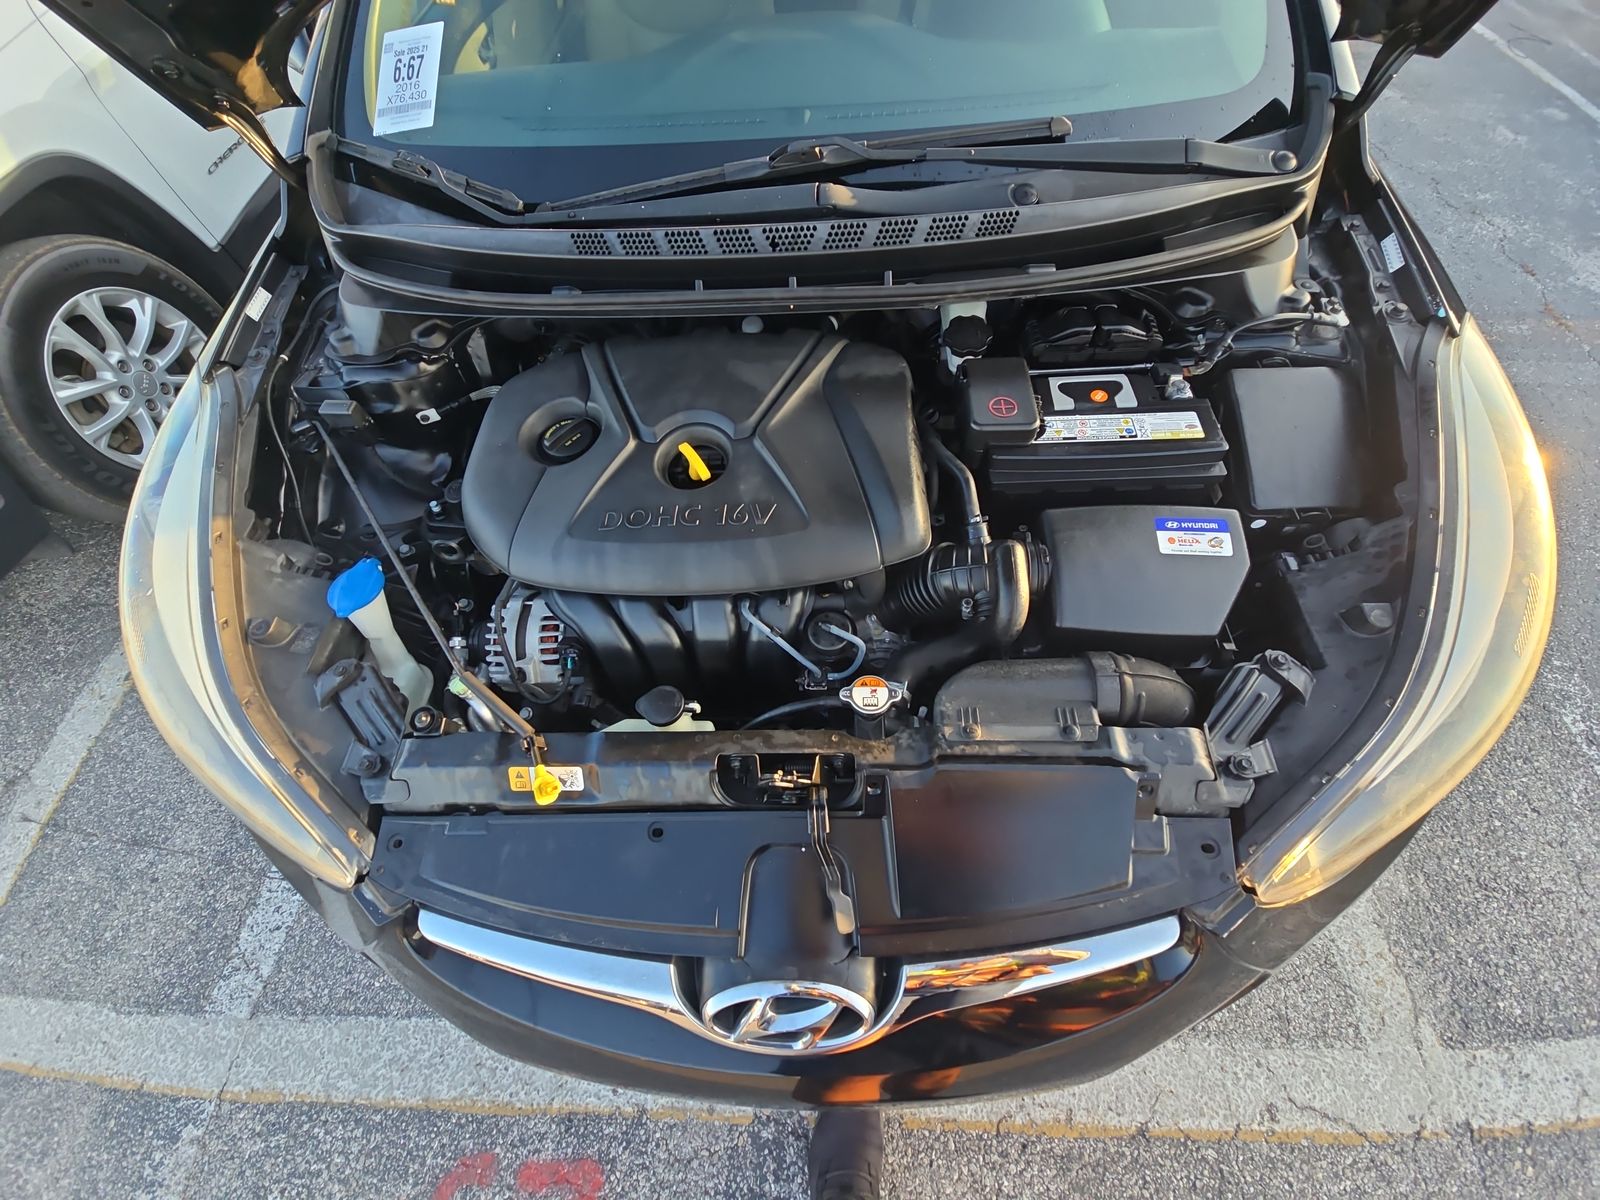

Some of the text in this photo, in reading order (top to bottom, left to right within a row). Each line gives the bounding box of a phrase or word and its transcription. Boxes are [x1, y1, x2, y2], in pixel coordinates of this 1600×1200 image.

[393, 48, 406, 58] Sale
[407, 46, 421, 55] 2025
[393, 54, 425, 83] 6:67
[395, 80, 420, 93] 2016
[598, 503, 778, 531] DOHC 16V
